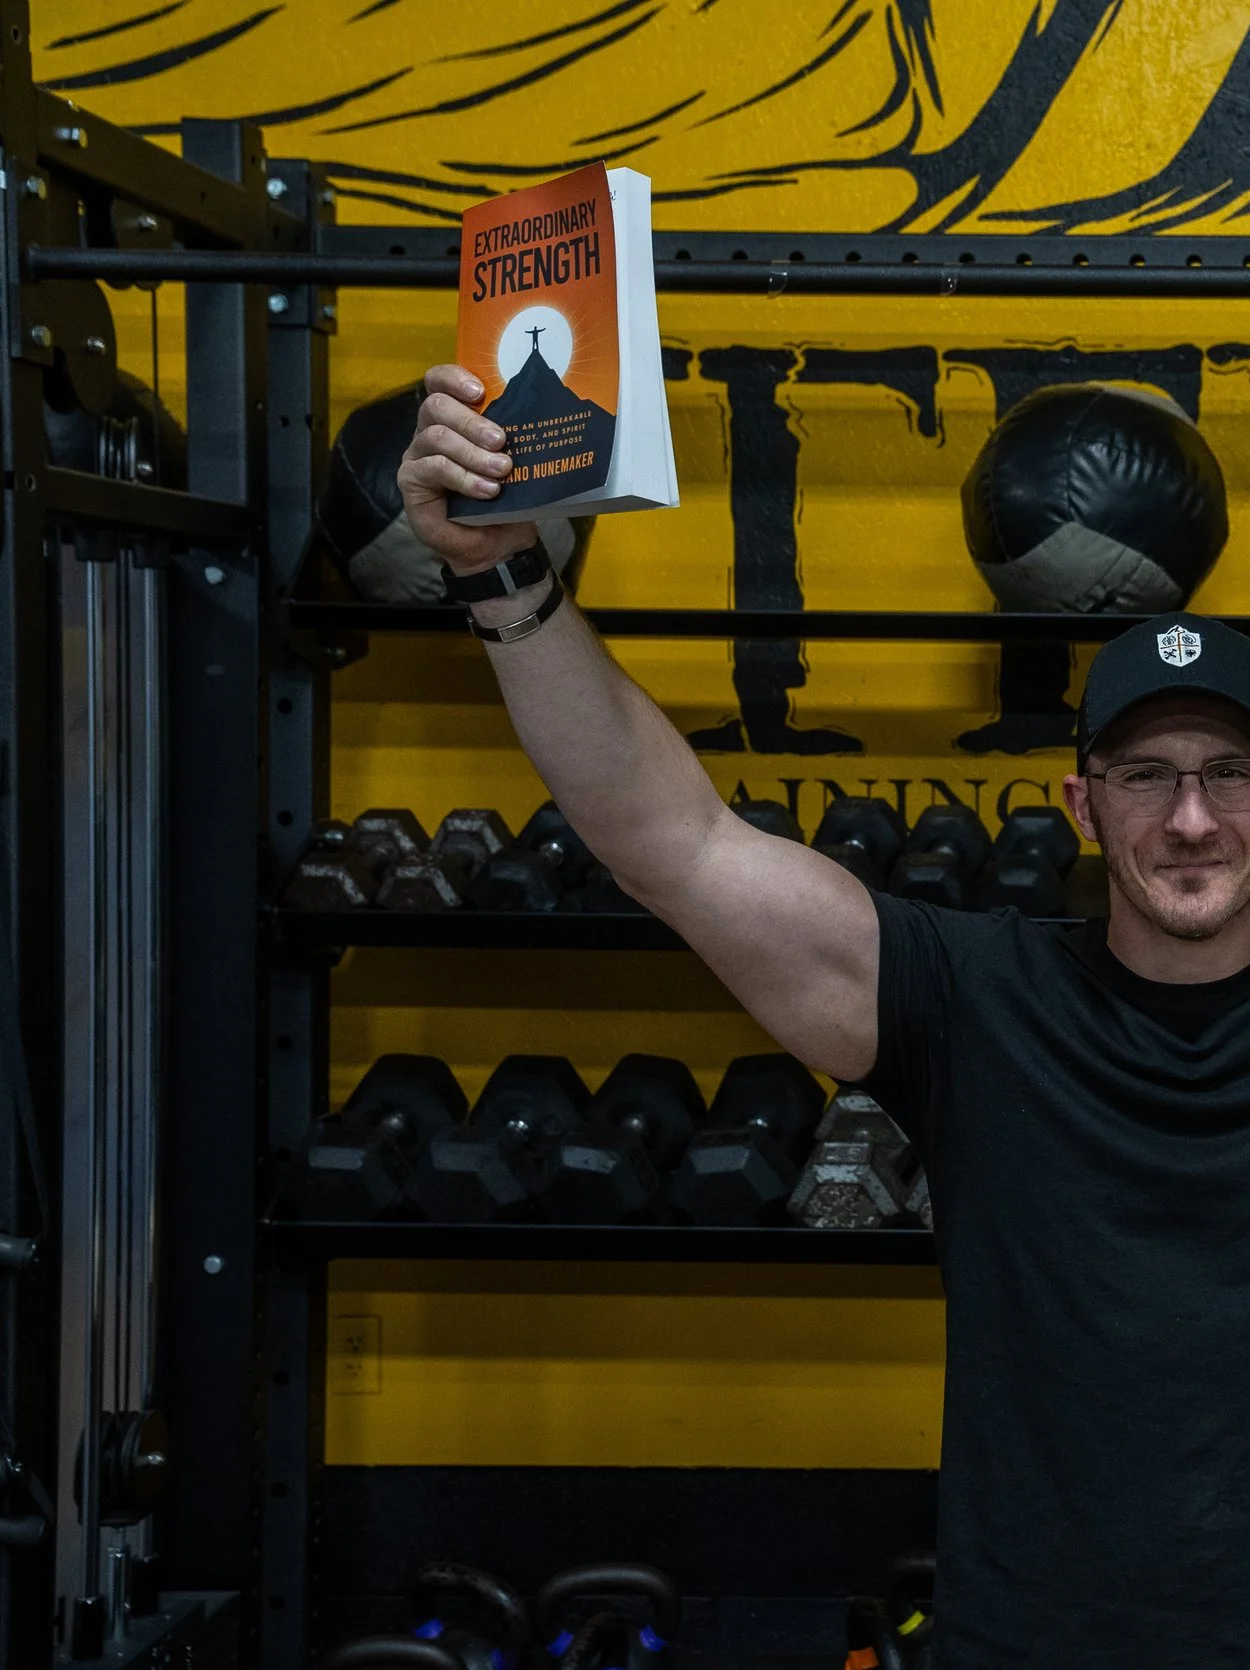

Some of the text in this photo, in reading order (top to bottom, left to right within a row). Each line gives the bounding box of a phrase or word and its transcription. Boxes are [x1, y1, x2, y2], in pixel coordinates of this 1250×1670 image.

[474, 198, 597, 258] EXTRAORDINARY
[472, 231, 600, 302] STRENGTH
[522, 422, 534, 431] AN
[537, 410, 592, 428] UNBREAKABLE
[514, 434, 539, 444] BODY,
[542, 429, 559, 439] AND
[562, 423, 586, 435] SPIRIT
[515, 446, 532, 455] LIFE
[536, 443, 546, 451] OF
[549, 435, 583, 448] PURPOSE
[533, 451, 594, 480] NUNEMAKER
